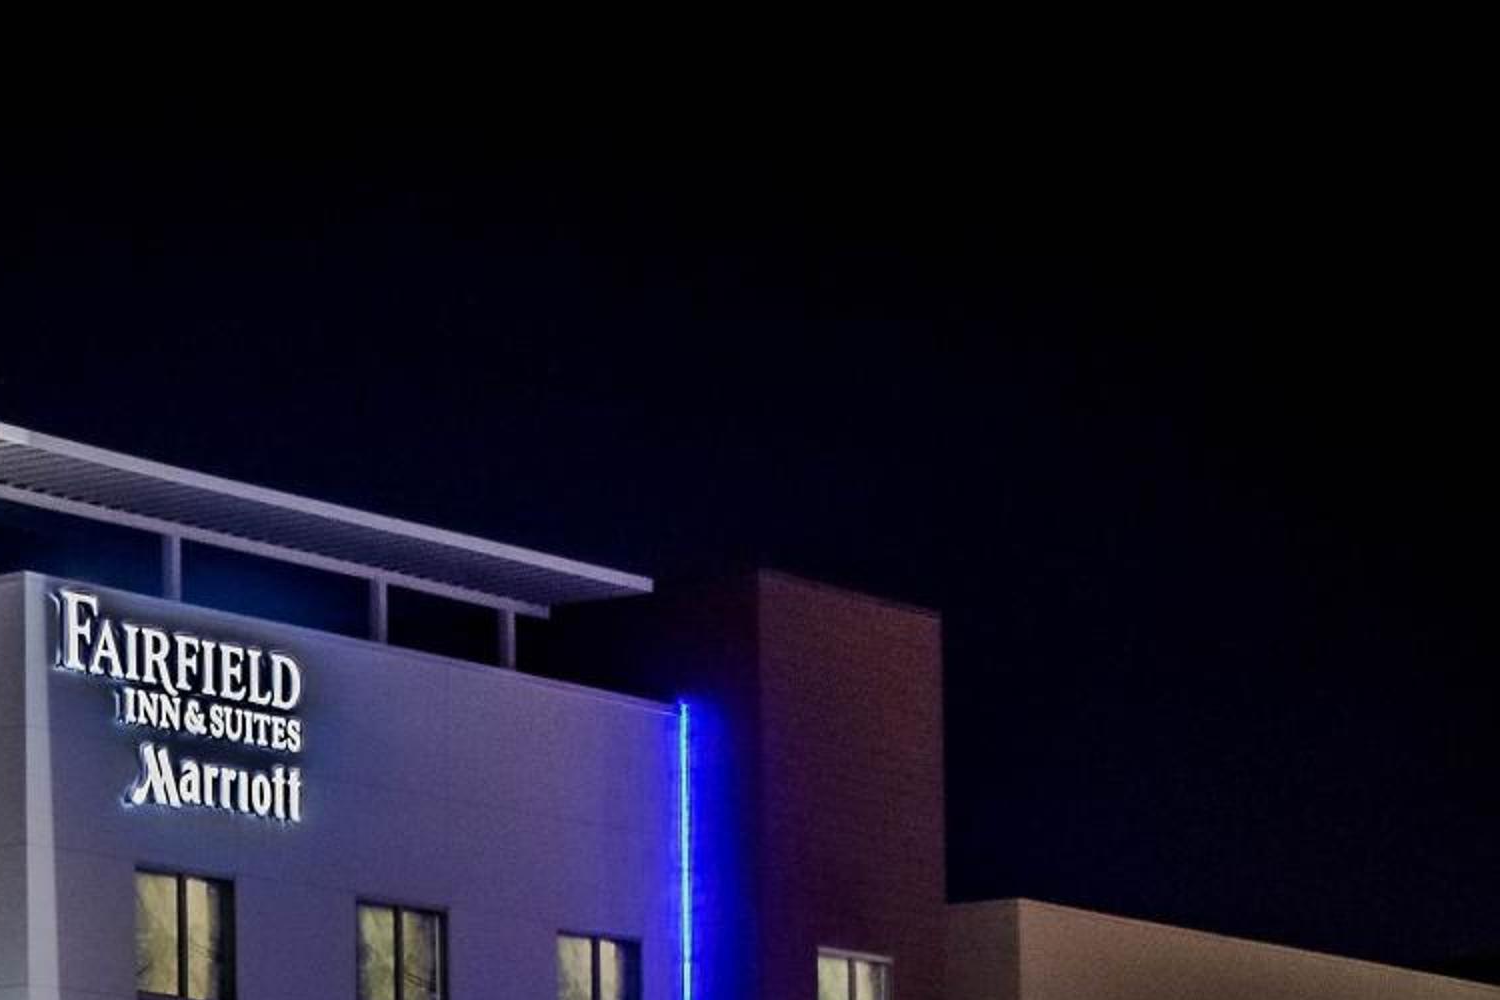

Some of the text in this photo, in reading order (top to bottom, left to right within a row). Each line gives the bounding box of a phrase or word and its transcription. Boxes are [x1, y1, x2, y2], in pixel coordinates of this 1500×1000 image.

[56, 590, 301, 711] FAIRFIELD
[120, 687, 301, 753] INN & SUITES
[127, 743, 301, 823] Marriott
